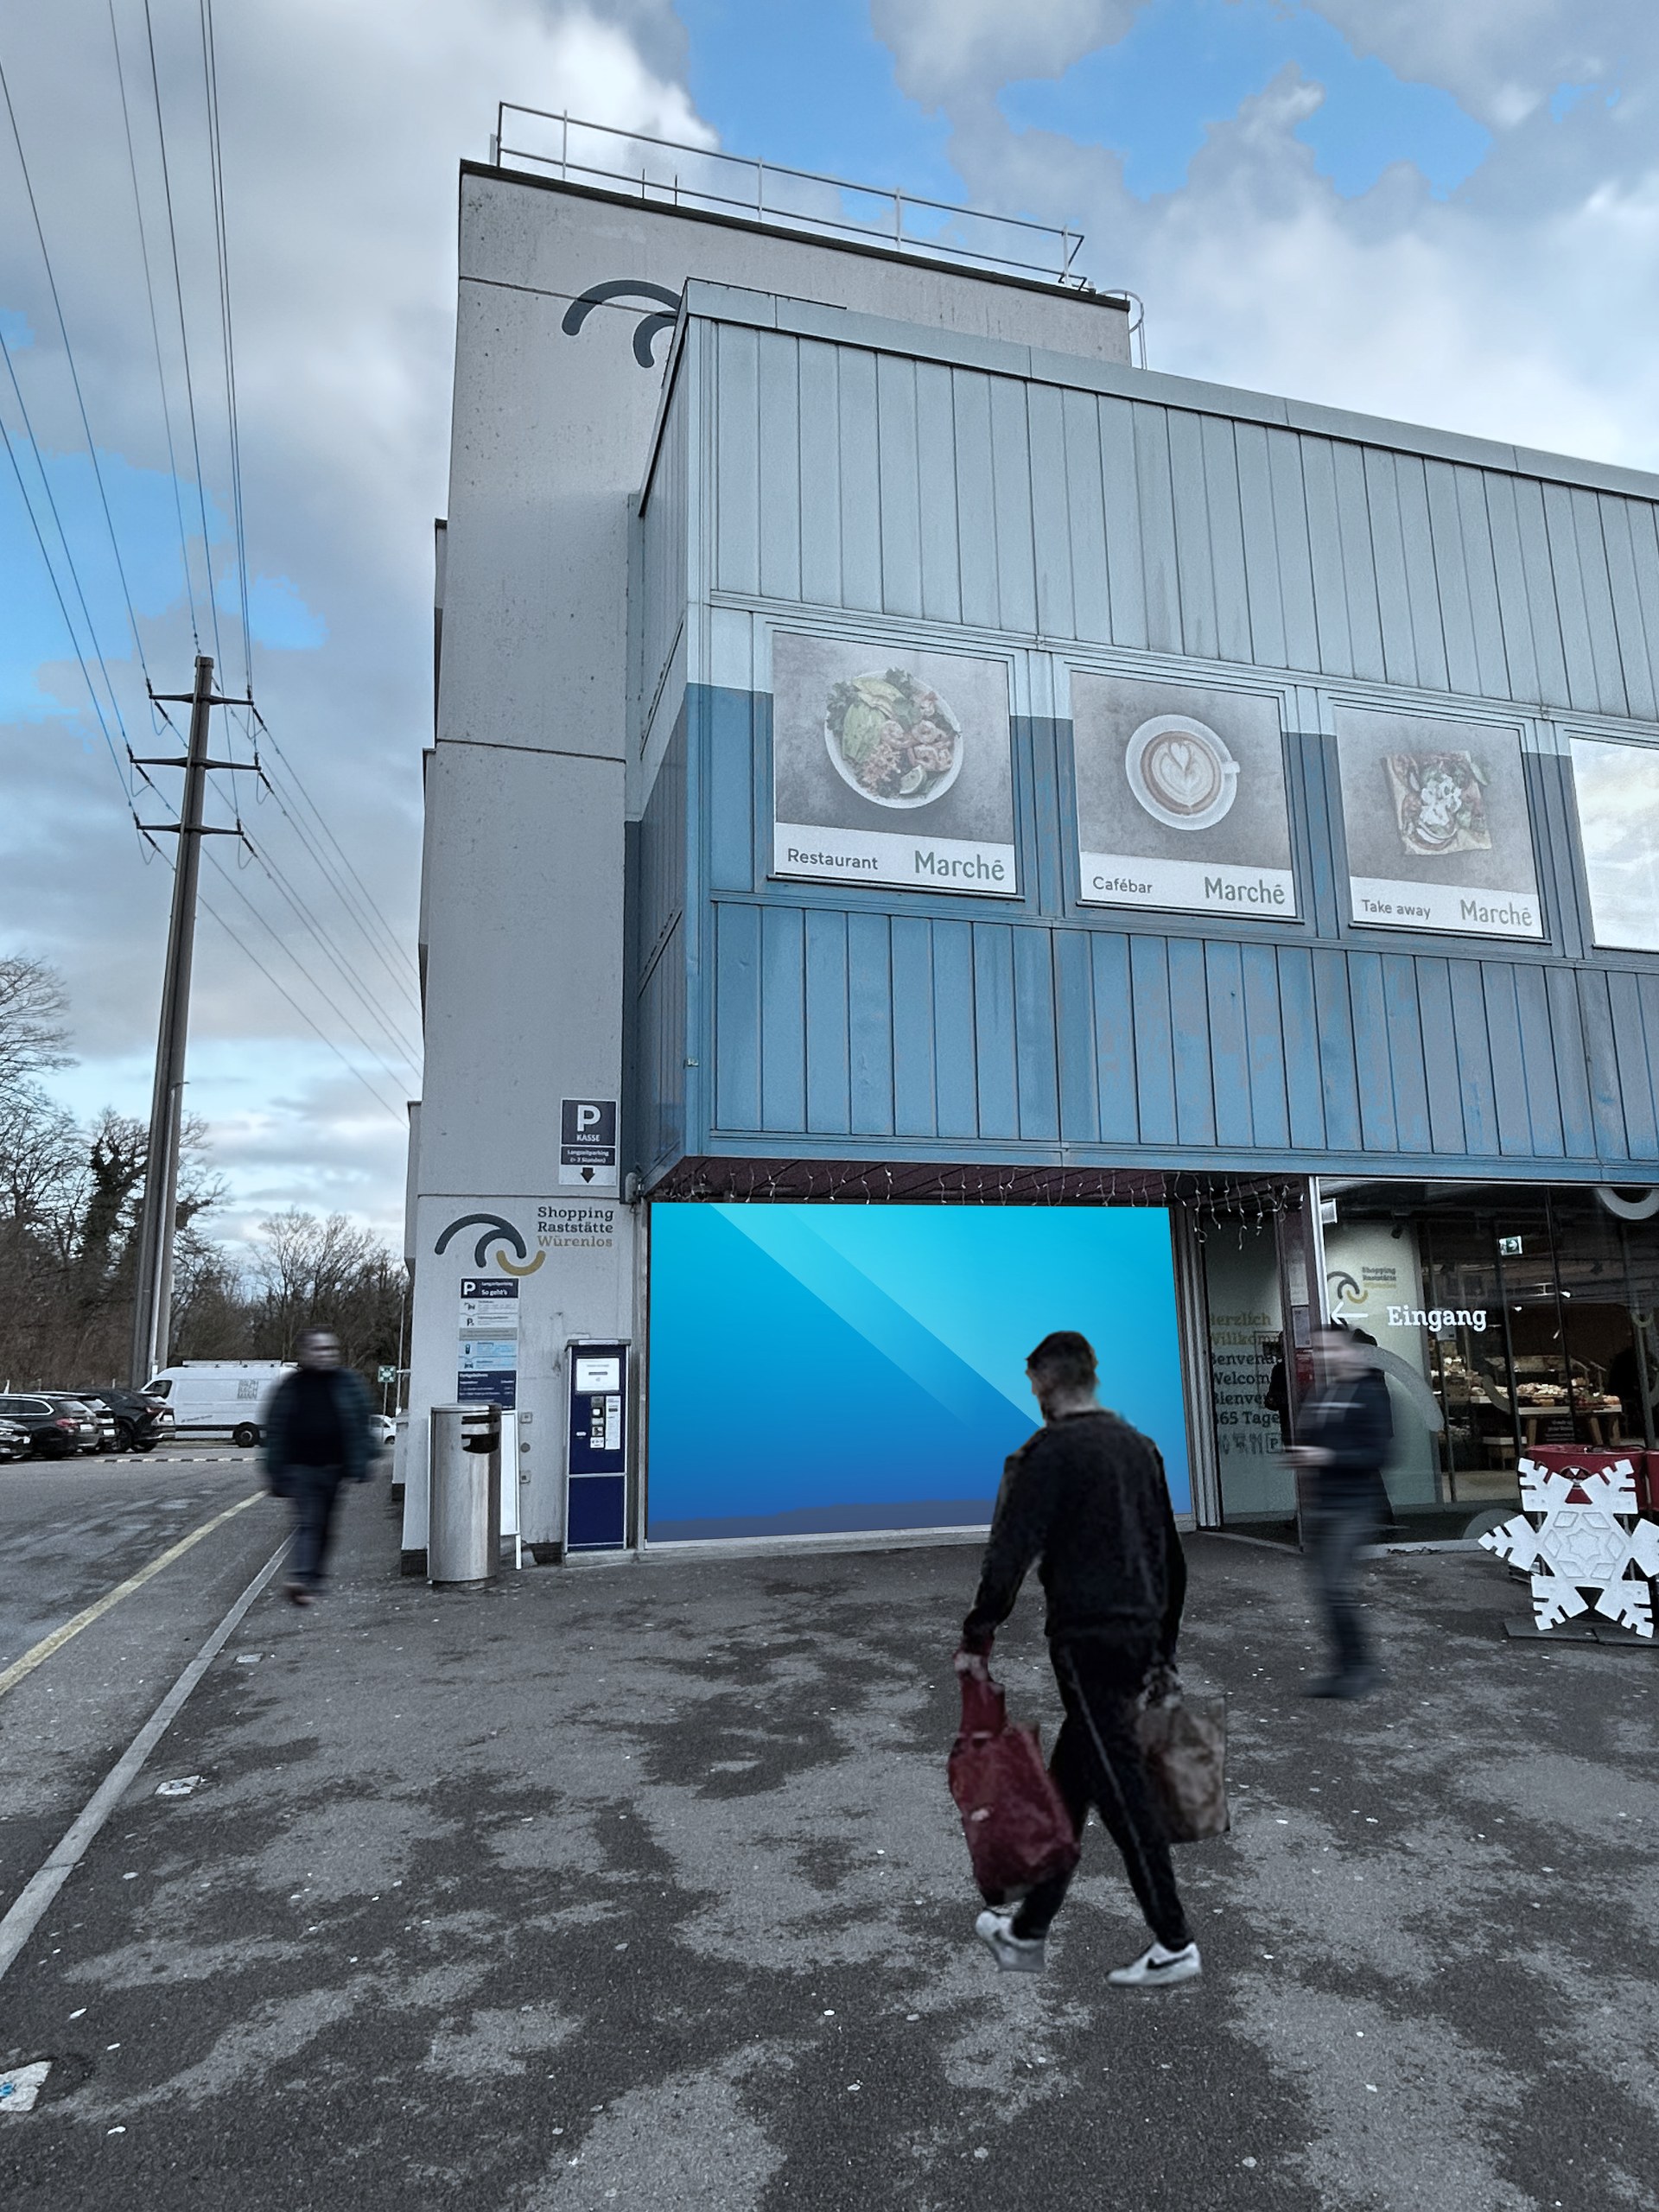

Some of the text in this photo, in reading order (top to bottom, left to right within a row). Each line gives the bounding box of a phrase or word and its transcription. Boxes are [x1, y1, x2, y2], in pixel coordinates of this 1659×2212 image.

[787, 848, 879, 870] Restaurant
[1092, 876, 1153, 894] Cafébar
[1362, 899, 1431, 920] Take away
[1459, 899, 1533, 926] Marché
[577, 1104, 601, 1132] P
[537, 1206, 614, 1222] Shopping
[537, 1221, 613, 1233] Raststätte
[537, 1236, 613, 1247] Würenlos
[464, 1281, 476, 1295] P
[1386, 1305, 1487, 1332] Eingang
[1213, 1371, 1272, 1384] Welcom
[1242, 1411, 1280, 1427] Tage
